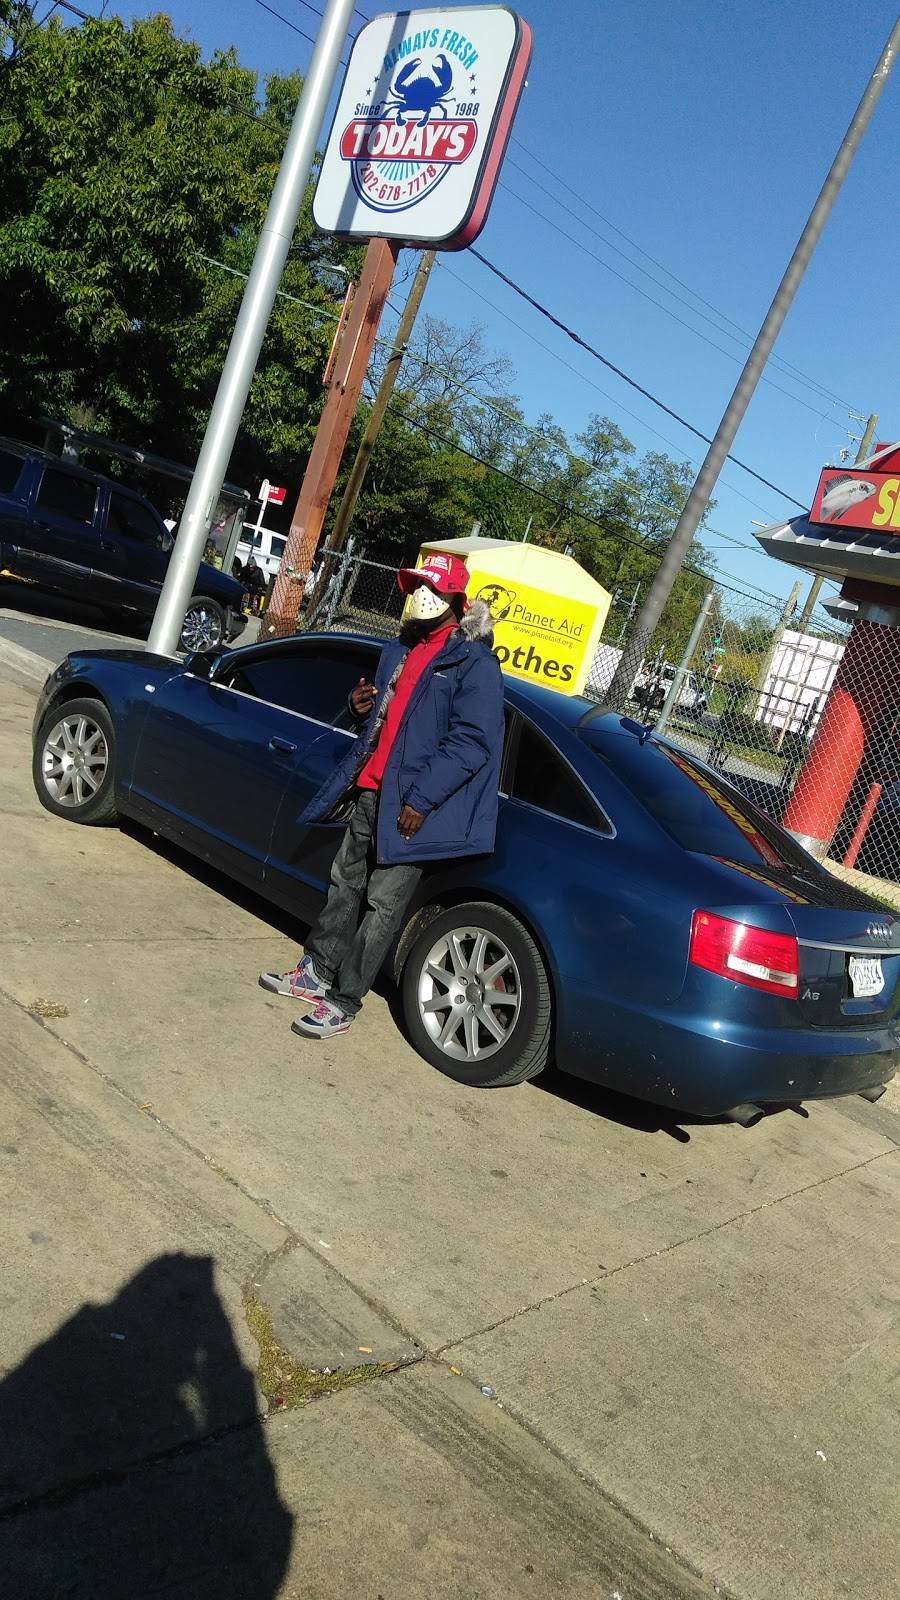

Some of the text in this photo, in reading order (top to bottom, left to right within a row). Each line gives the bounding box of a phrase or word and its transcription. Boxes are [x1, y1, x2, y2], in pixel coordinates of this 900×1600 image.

[384, 28, 479, 72] ALWAYS FRESH
[354, 103, 480, 116] Since 1988
[352, 124, 469, 158] TODAY'S
[360, 163, 437, 201] 202-678-7778
[513, 604, 584, 637] Planet Aid
[513, 625, 574, 649] www.planetaid.org
